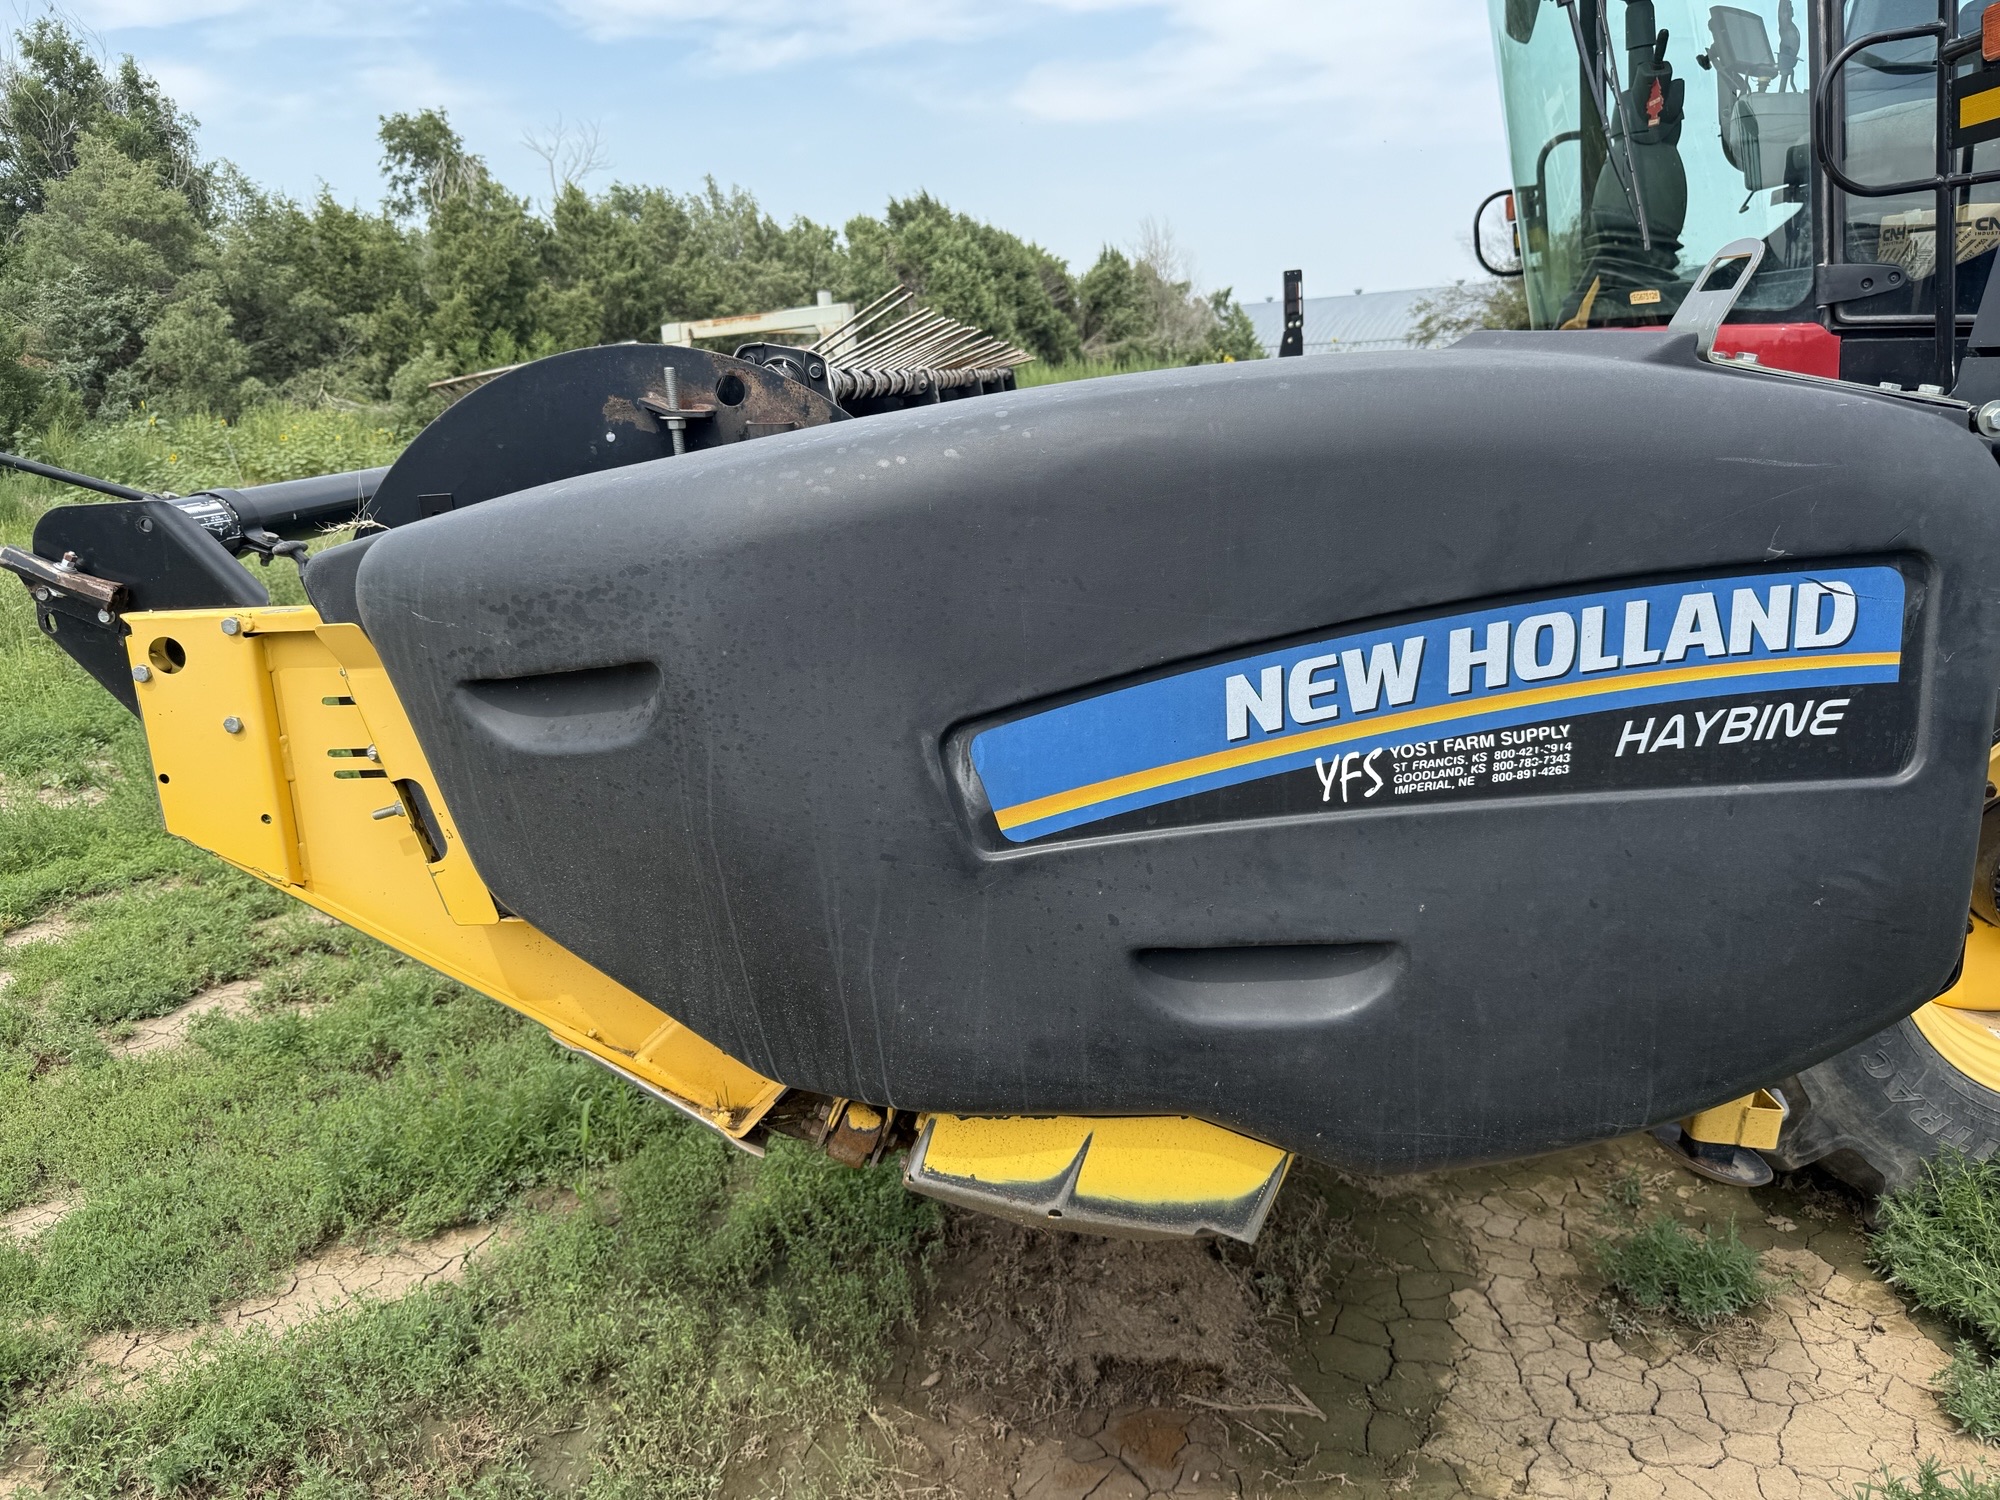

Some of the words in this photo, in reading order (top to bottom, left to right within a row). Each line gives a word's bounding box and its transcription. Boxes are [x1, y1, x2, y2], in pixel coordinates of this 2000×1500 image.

[1224, 634, 1426, 743] NEW
[1447, 580, 1859, 696] HOLLAND
[1389, 737, 1439, 760] YOST
[1443, 731, 1496, 757] FARM
[1500, 723, 1573, 747] SUPPLY
[1614, 697, 1851, 758] HAYBINE
[1314, 746, 1384, 803] YFS
[1392, 761, 1408, 774] ST
[1471, 751, 1488, 764] KS
[1394, 779, 1456, 796] IMPERIAL,
[1458, 775, 1476, 788] NE
[1491, 764, 1570, 784] 800-891-4263
[1470, 762, 1487, 775] KS
